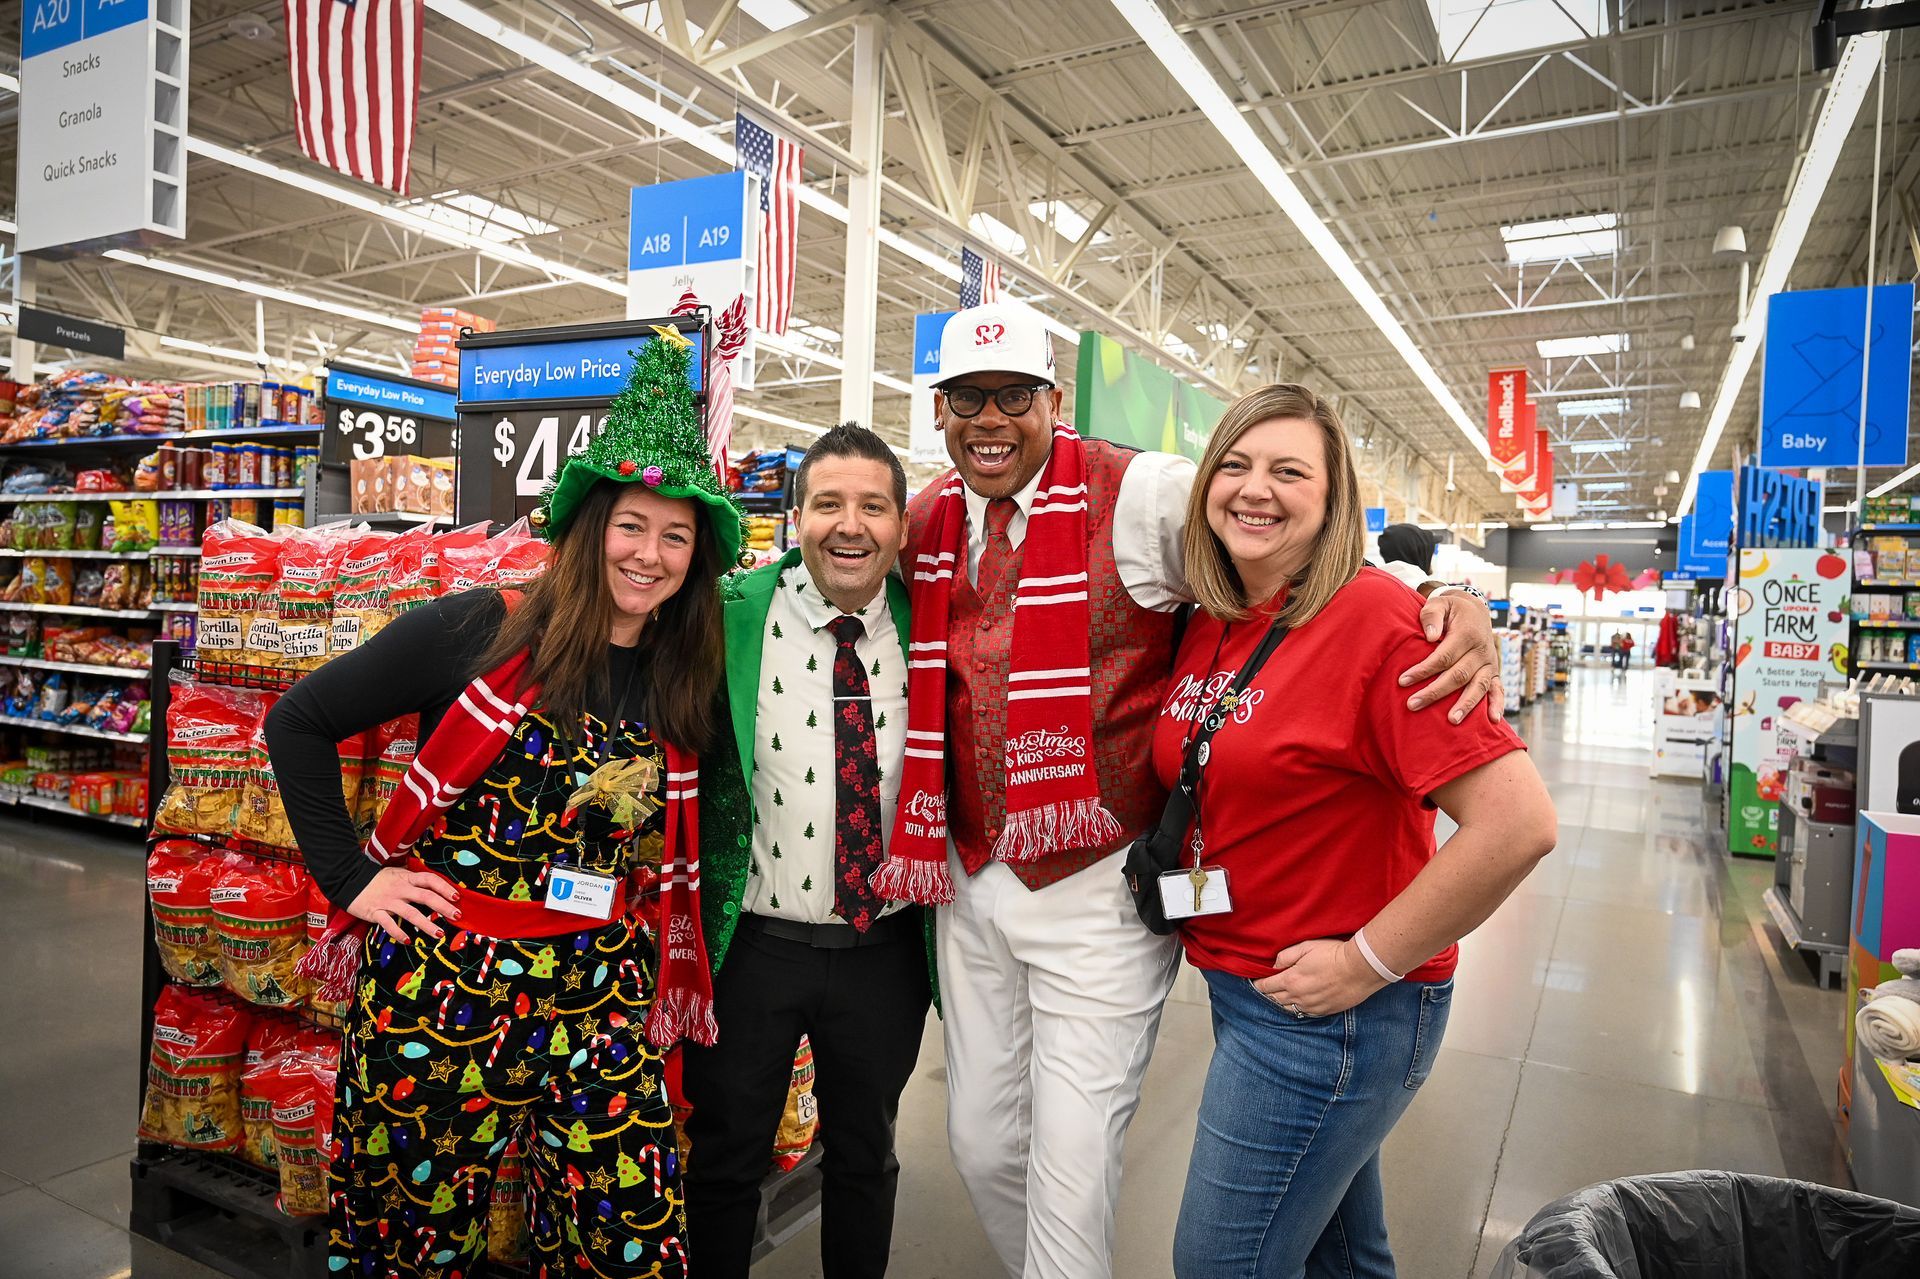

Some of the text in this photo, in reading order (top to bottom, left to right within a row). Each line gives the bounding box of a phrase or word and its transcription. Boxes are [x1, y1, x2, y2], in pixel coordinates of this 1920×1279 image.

[32, 0, 70, 34] A20
[63, 53, 101, 78] Snacks
[58, 102, 102, 128] Granola
[43, 150, 117, 181] Quick Snacks
[641, 225, 730, 255] A18 A19
[672, 275, 695, 287] Jelly
[56, 326, 91, 342] Pretzels
[475, 358, 621, 388] Everyday Low Price
[337, 378, 424, 405] Everyday Low Price
[1498, 374, 1515, 438] Rollback
[1782, 433, 1827, 452] Baby
[346, 559, 371, 569] Gluten
[1763, 579, 1820, 606] ONCE
[1766, 608, 1818, 642] FARM
[201, 633, 235, 648] Chips
[249, 633, 279, 649] Chips
[280, 628, 323, 642] Tortilla
[284, 642, 319, 655] Chips
[1770, 643, 1816, 659] BABY
[1767, 667, 1795, 676] Better
[1800, 668, 1826, 679] Story
[1762, 678, 1790, 686] Starts
[177, 729, 207, 739] Gluten
[1010, 763, 1086, 786] ANNIVERSARY
[905, 821, 924, 837] 10TH
[156, 881, 173, 889] Free
[577, 880, 604, 889] JORDAN
[225, 890, 242, 898] Free
[311, 916, 325, 924] Free
